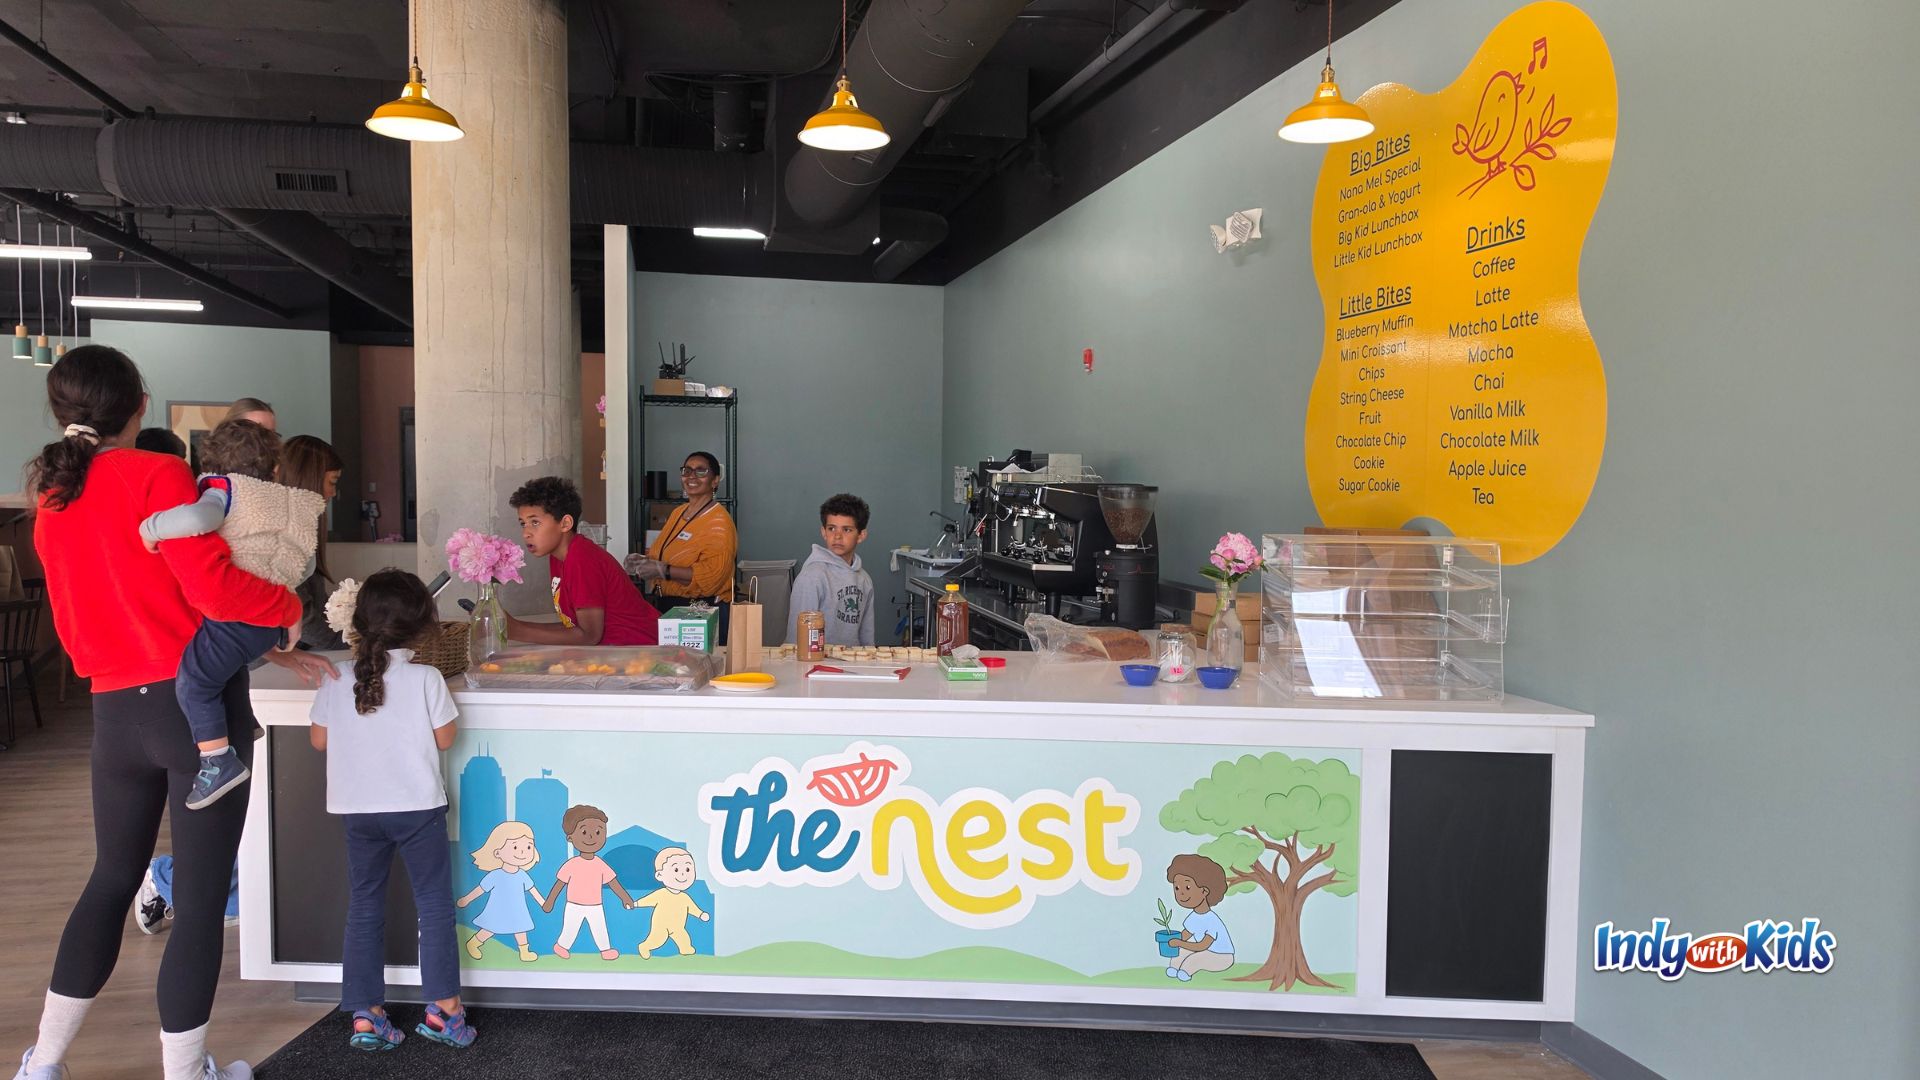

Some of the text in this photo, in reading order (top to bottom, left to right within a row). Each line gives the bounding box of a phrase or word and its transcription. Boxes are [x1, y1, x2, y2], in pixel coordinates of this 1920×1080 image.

[1351, 134, 1411, 172] Big Bites
[1339, 156, 1421, 202] Nana Mel Special
[1338, 183, 1421, 224] Gran-ola & Yogurt
[1338, 209, 1419, 246] Big Kid Lunchbox
[1467, 216, 1525, 249] Drinks
[1334, 231, 1423, 268] Little Kid Lunchbox
[1473, 256, 1516, 278] Coffee
[1340, 286, 1411, 316] Little Bites
[1475, 286, 1510, 307] Latte
[1336, 314, 1414, 341] Blueberry Muffin
[1448, 310, 1539, 339] Matcha Latte
[1340, 340, 1407, 362] Mini Croissant
[1468, 344, 1514, 364] Mocha
[1358, 366, 1385, 382] Chips
[1474, 372, 1505, 391] Chai
[1340, 388, 1405, 406] String Cheese
[1359, 410, 1382, 424] Fruit
[1450, 400, 1526, 421] Vanilla Milk
[1335, 432, 1407, 449] Chocolate Chip
[1440, 429, 1540, 449] Chocolate Milk
[1354, 456, 1385, 470] Cookie
[1448, 459, 1527, 480] Apple Juice
[1339, 477, 1401, 495] Sugar Cookie
[1472, 487, 1495, 505] Tea
[711, 770, 1130, 915] the nest
